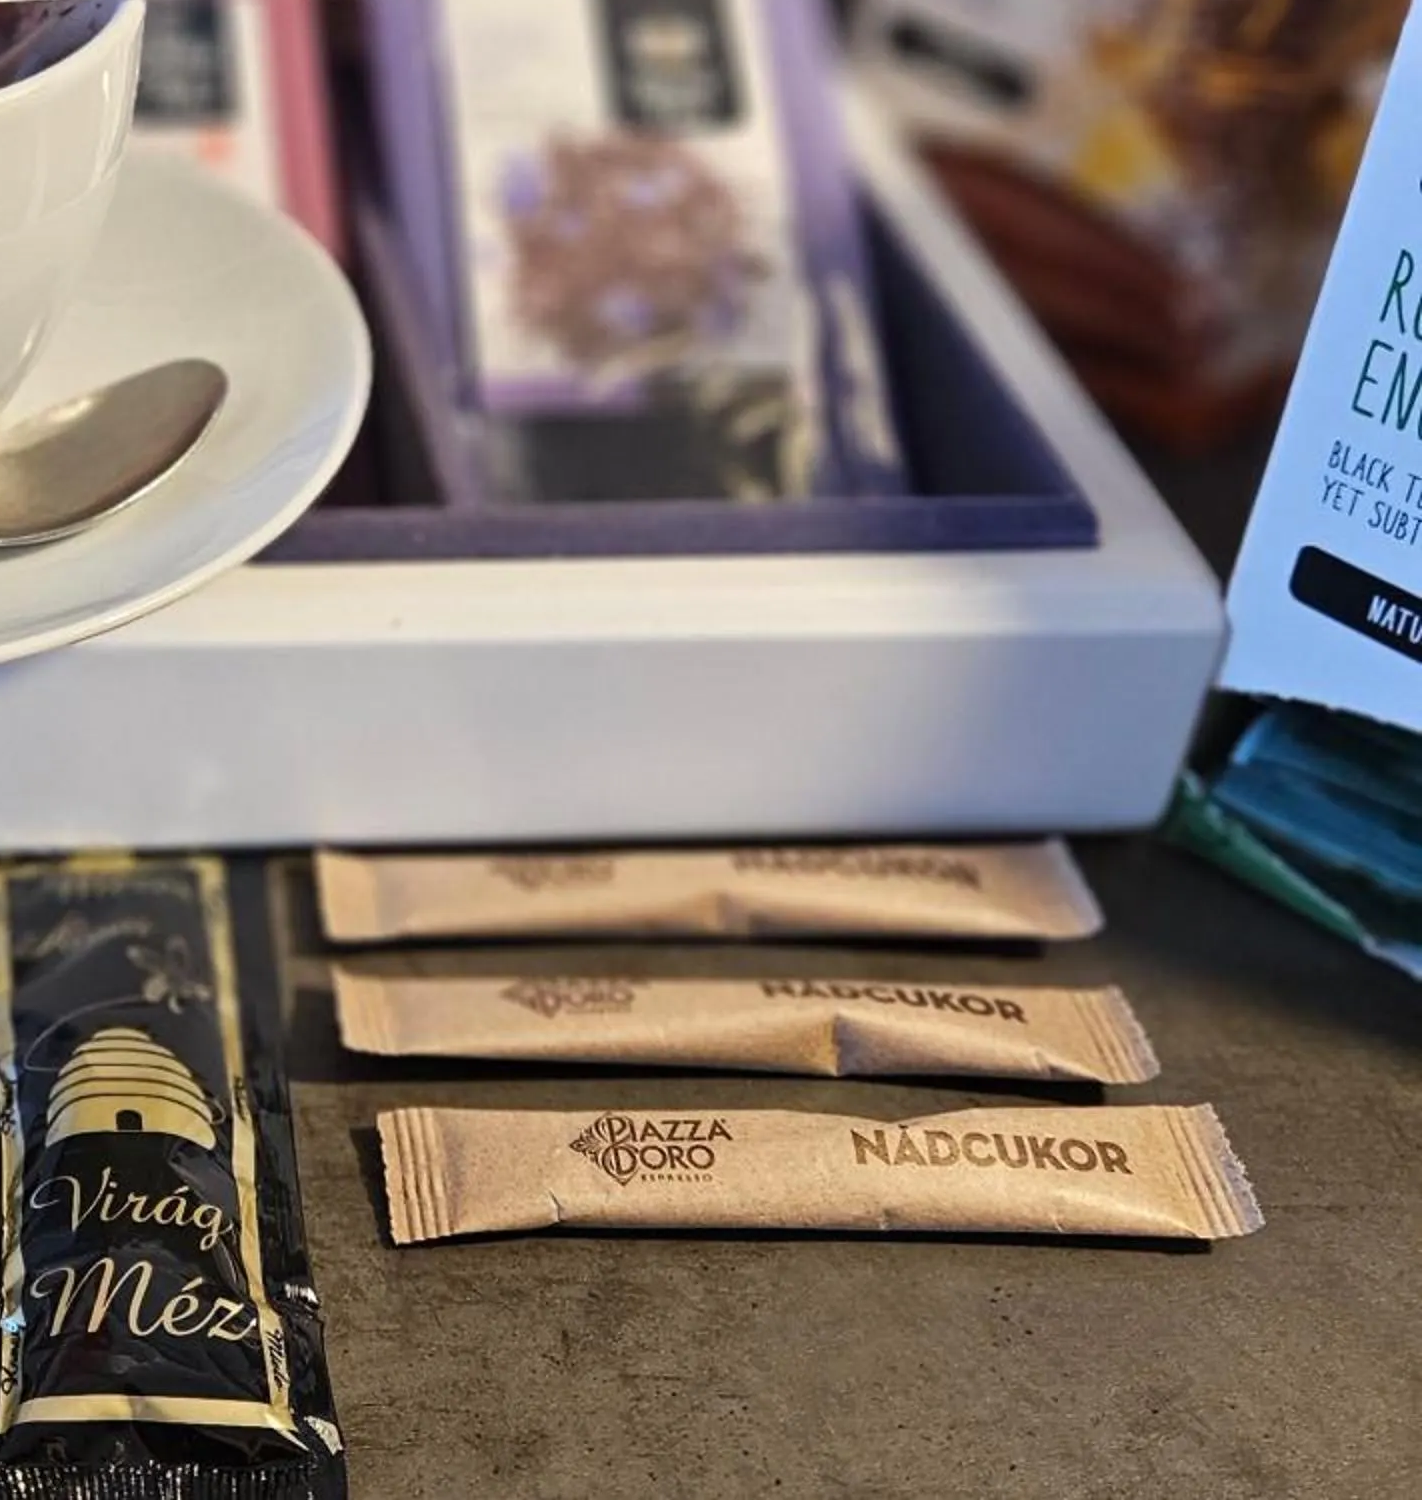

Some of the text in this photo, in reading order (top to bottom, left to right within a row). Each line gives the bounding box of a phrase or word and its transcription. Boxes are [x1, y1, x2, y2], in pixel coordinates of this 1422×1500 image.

[1352, 338, 1422, 441] EN
[1328, 439, 1395, 493] BLACK
[1321, 475, 1422, 546] YET SUBT
[1366, 594, 1422, 644] NATU
[595, 1114, 733, 1143] PIAZZA
[849, 1123, 1134, 1175] NÁDCUKOR
[30, 1166, 234, 1251] Virág
[30, 1257, 257, 1341] Méz
